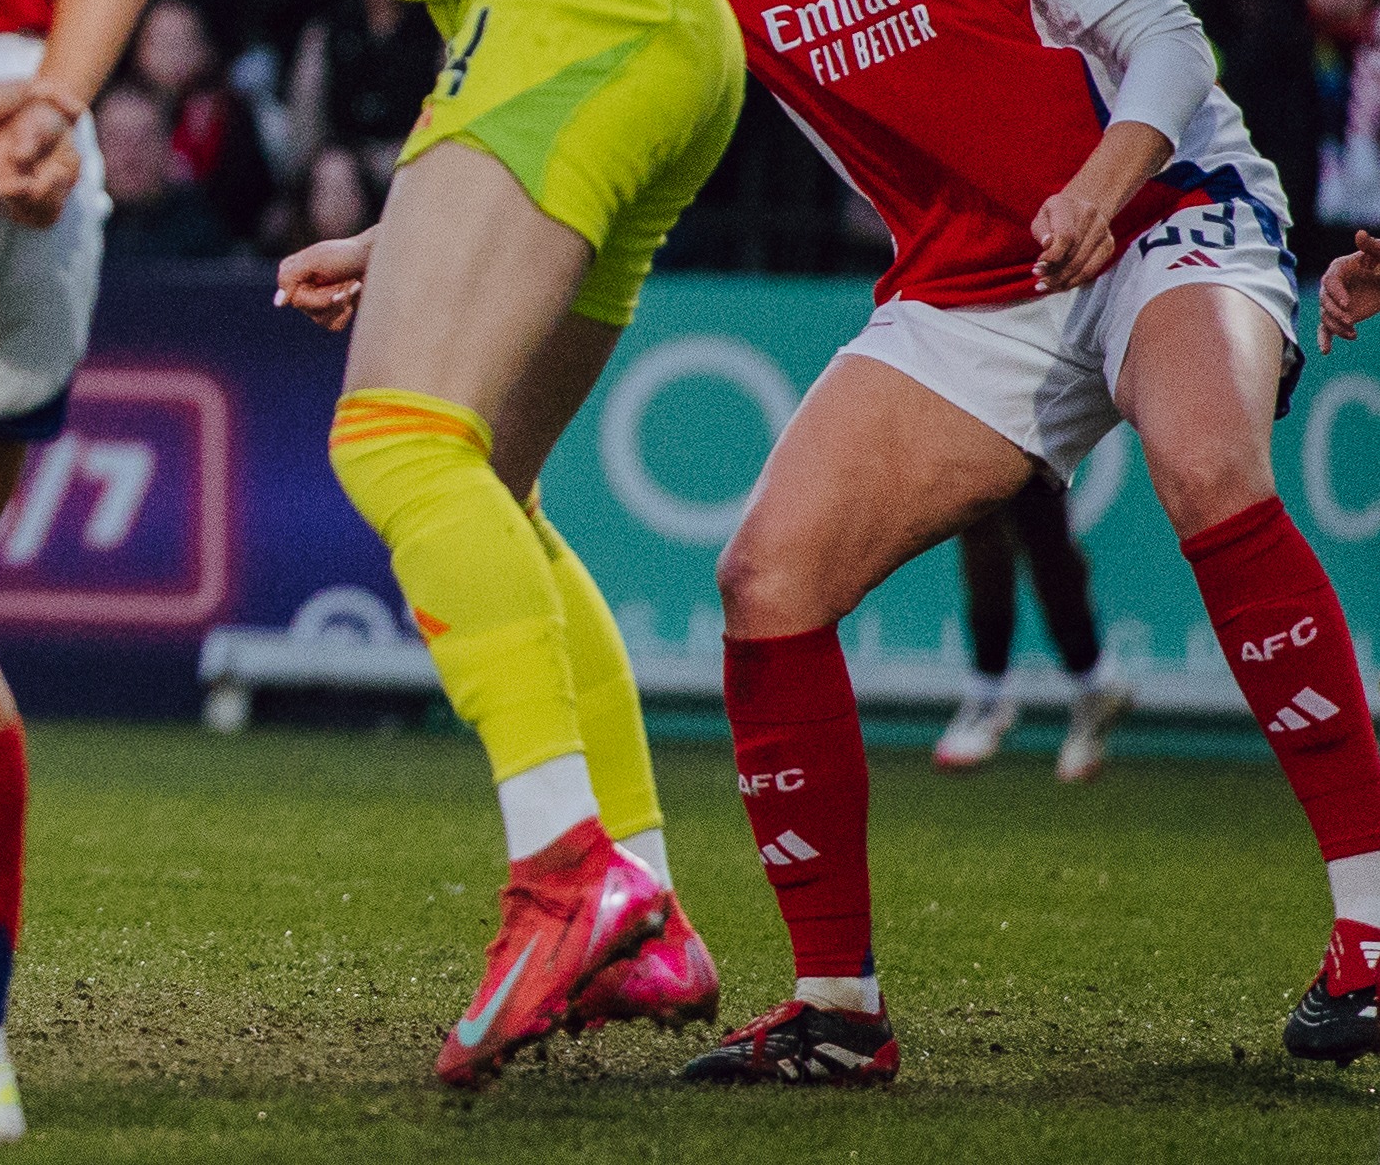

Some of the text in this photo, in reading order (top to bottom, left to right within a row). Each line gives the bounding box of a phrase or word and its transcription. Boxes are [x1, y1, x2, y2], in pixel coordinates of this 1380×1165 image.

[852, 3, 938, 70] BETTER
[809, 38, 850, 86] FLY
[1241, 616, 1318, 662] AFC
[738, 767, 806, 798] AFC
